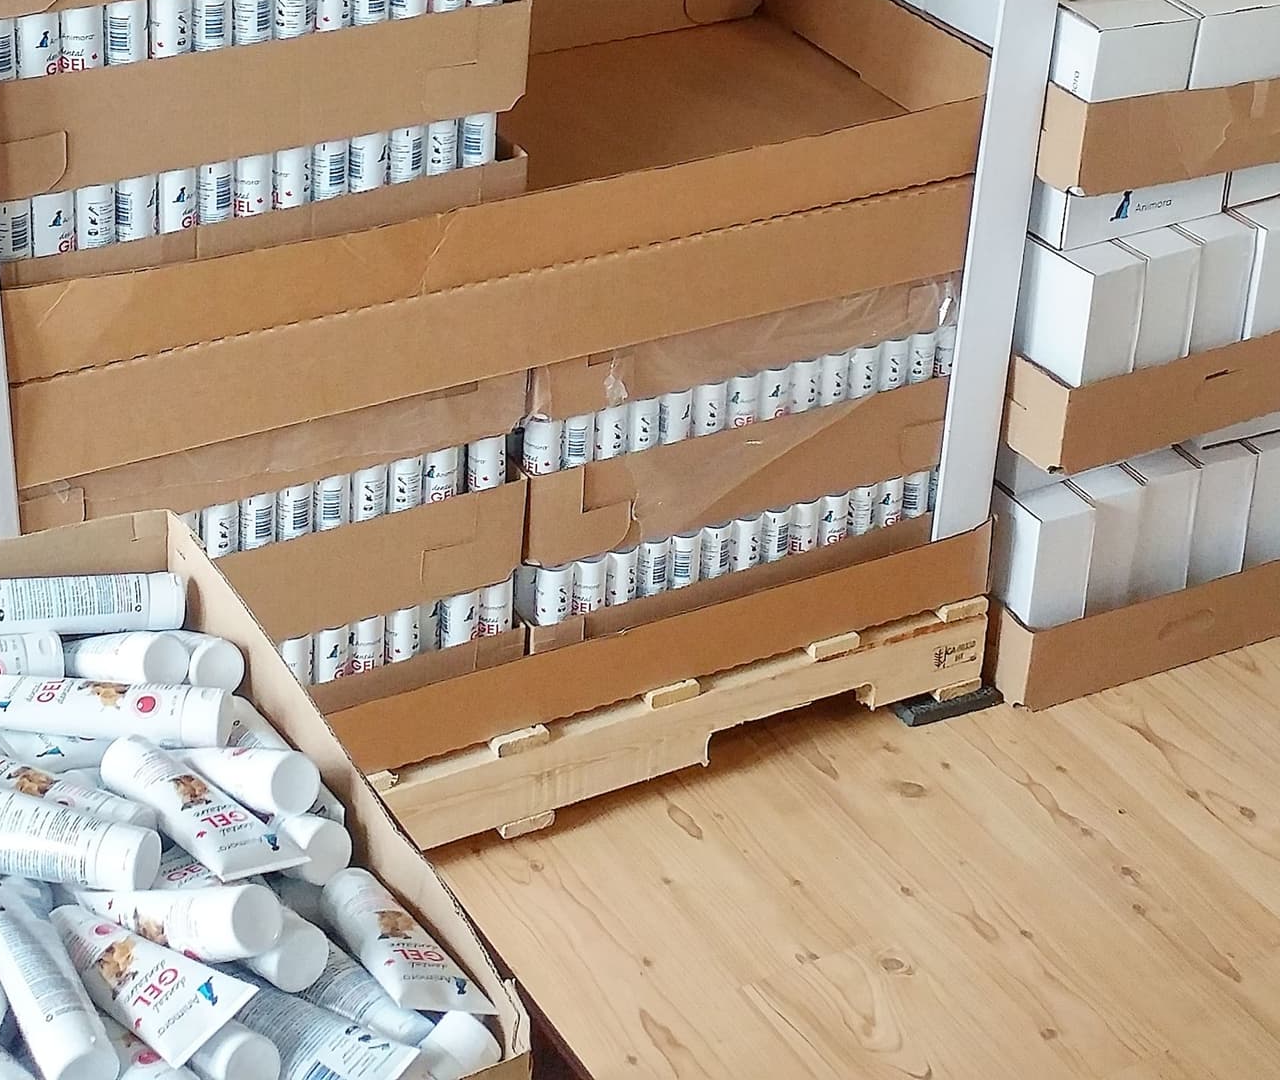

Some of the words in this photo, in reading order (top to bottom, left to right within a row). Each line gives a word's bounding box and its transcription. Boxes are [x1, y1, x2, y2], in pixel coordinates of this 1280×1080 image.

[1134, 197, 1173, 214] Animora
[37, 678, 66, 703] GEL
[200, 810, 249, 828] GEL
[166, 862, 203, 882] GE
[392, 948, 445, 963] GEL
[132, 968, 179, 1008] GEL
[158, 993, 200, 1039] Animora
